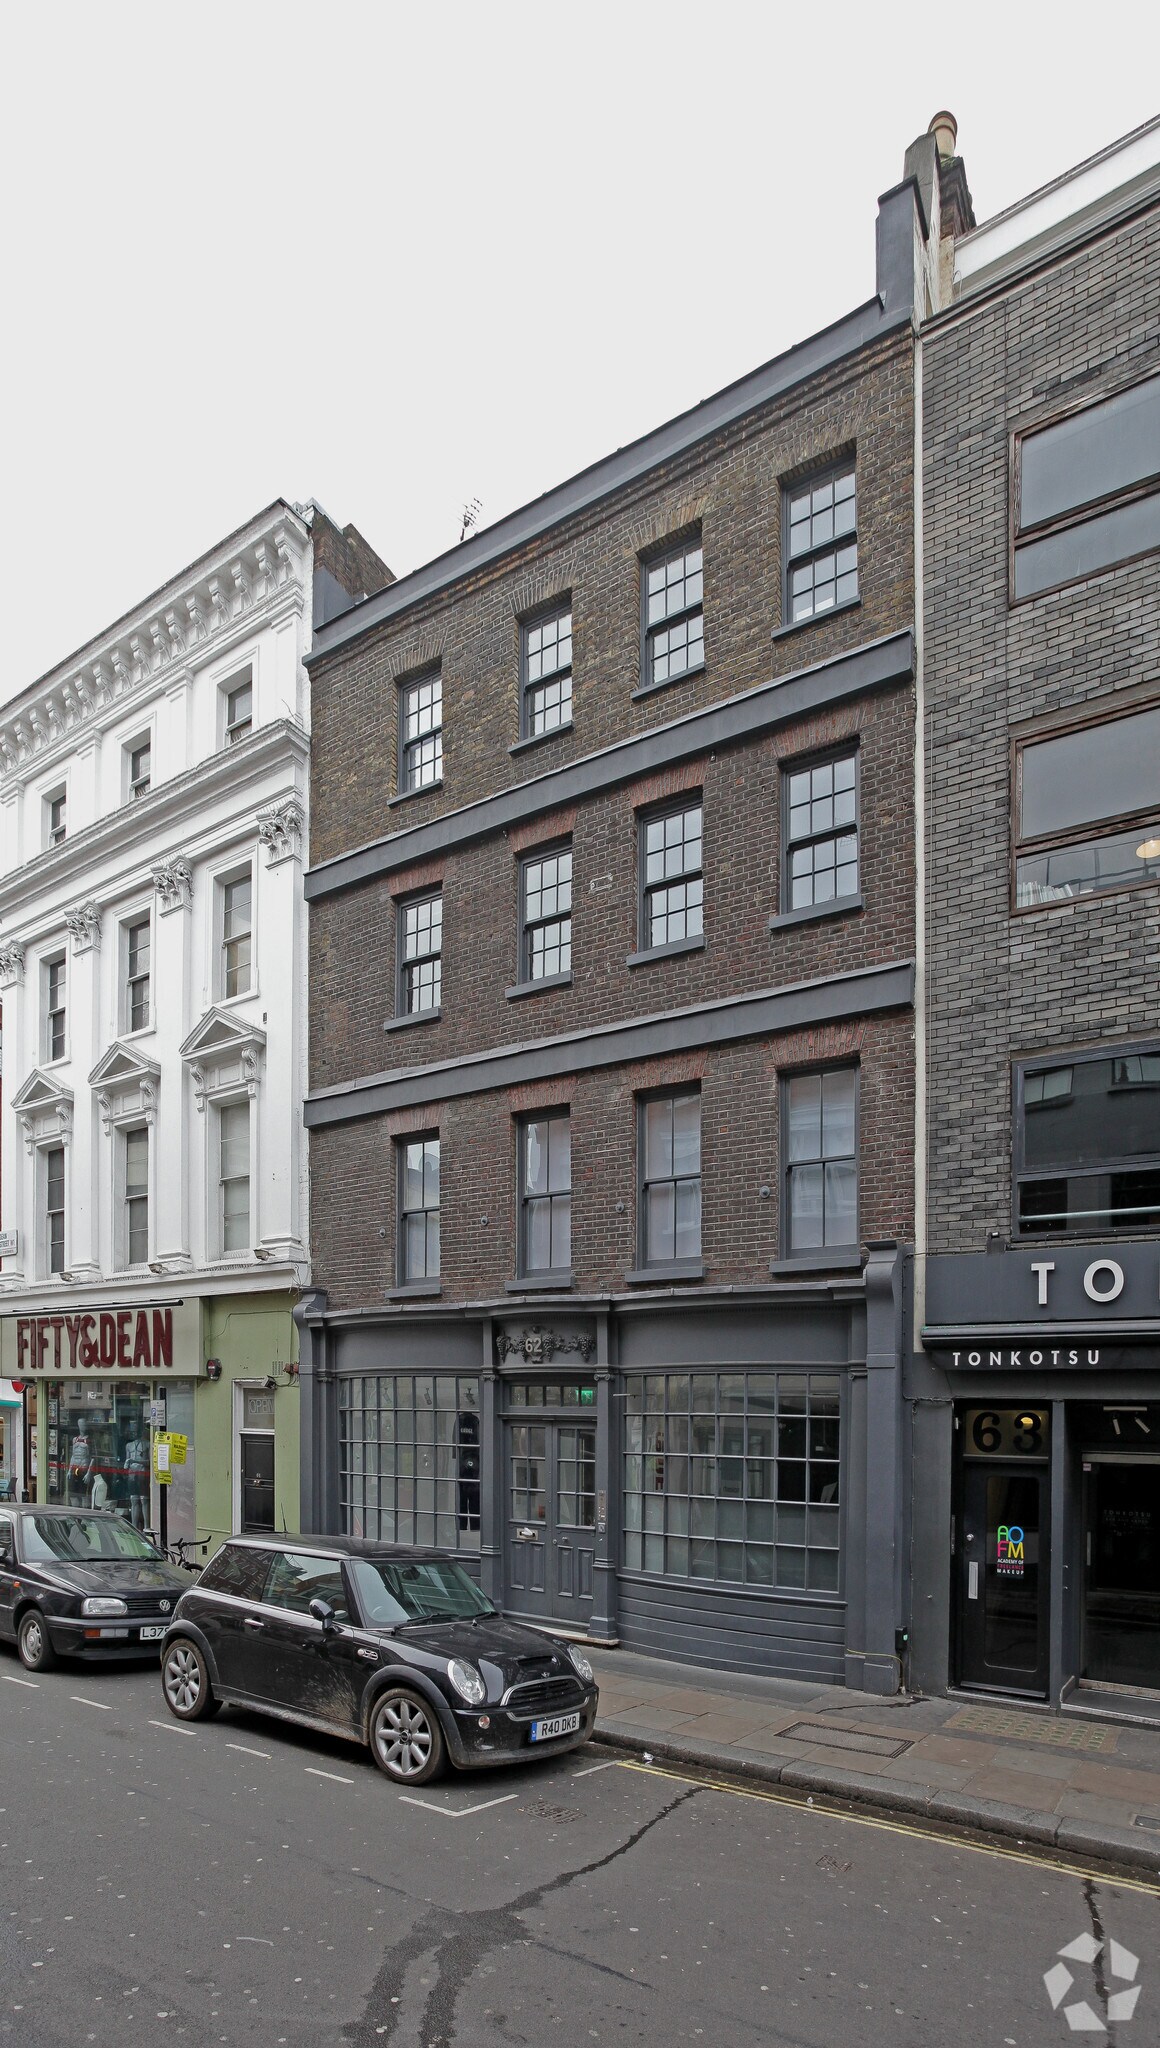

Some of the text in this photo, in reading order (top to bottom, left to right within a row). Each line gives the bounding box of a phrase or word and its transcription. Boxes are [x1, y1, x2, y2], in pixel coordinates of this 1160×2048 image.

[1031, 1259, 1160, 1304] TO
[16, 1308, 173, 1369] FIFTY&DEAN
[525, 1337, 542, 1353] 62
[952, 1350, 1099, 1366] TONKOTSU
[249, 1399, 274, 1413] OPEN
[973, 1412, 1043, 1454] 63
[541, 1716, 577, 1736] R40 DKB
